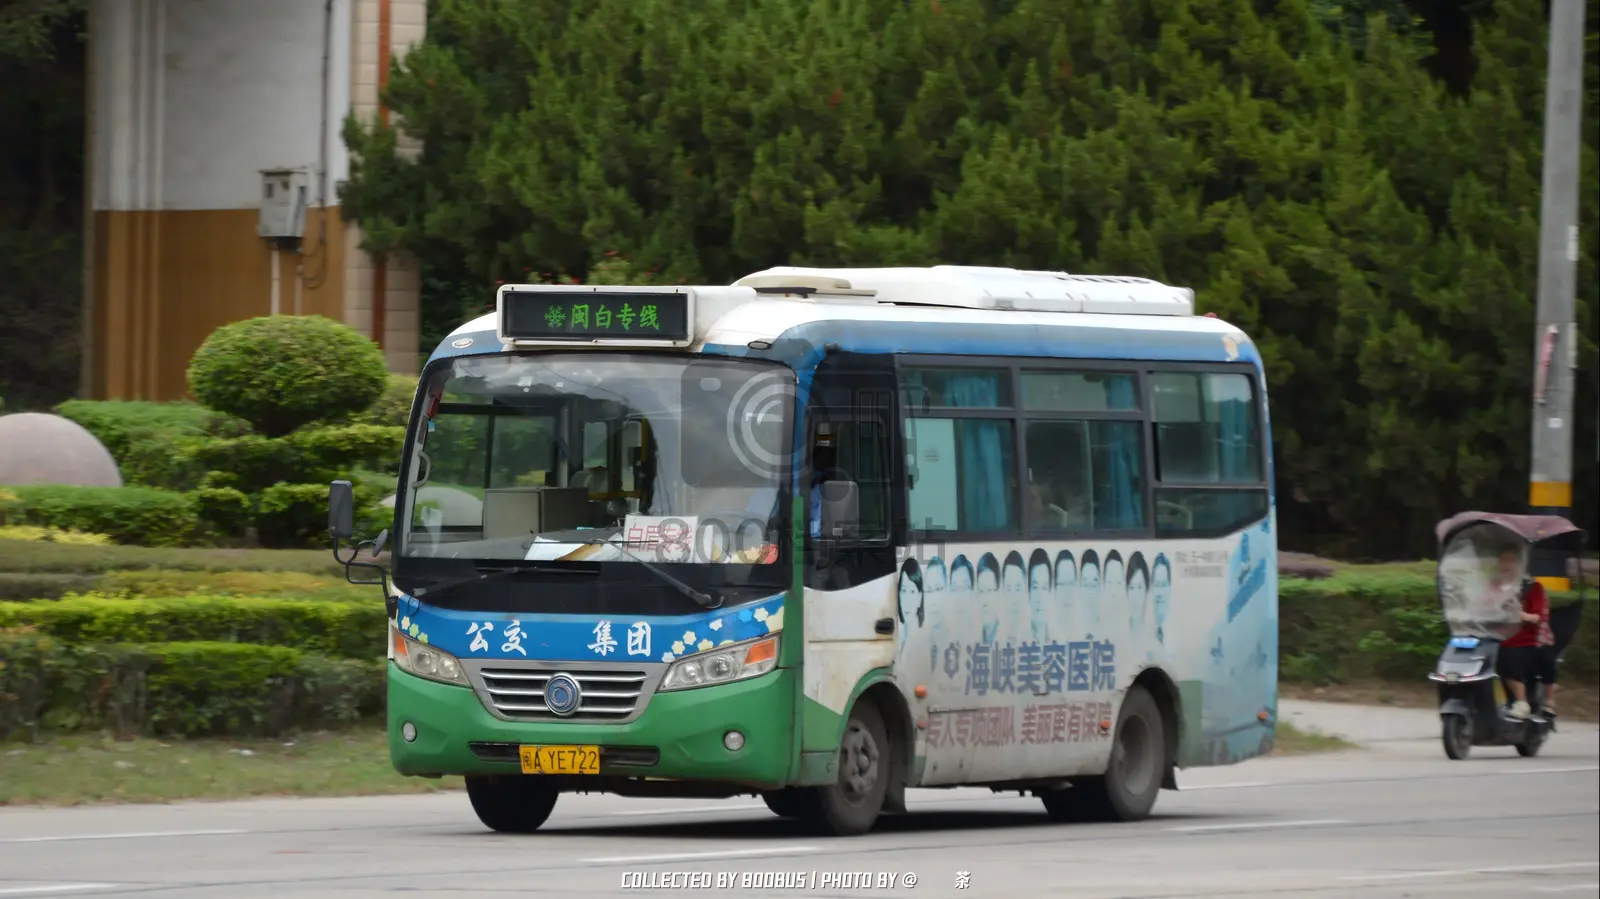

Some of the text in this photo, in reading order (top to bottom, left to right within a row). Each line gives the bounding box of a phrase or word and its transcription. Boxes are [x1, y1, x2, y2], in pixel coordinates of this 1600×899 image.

[571, 303, 660, 330] 闽白专线
[466, 619, 652, 657] 公交 集团
[965, 639, 1115, 696] 海峡美容医院
